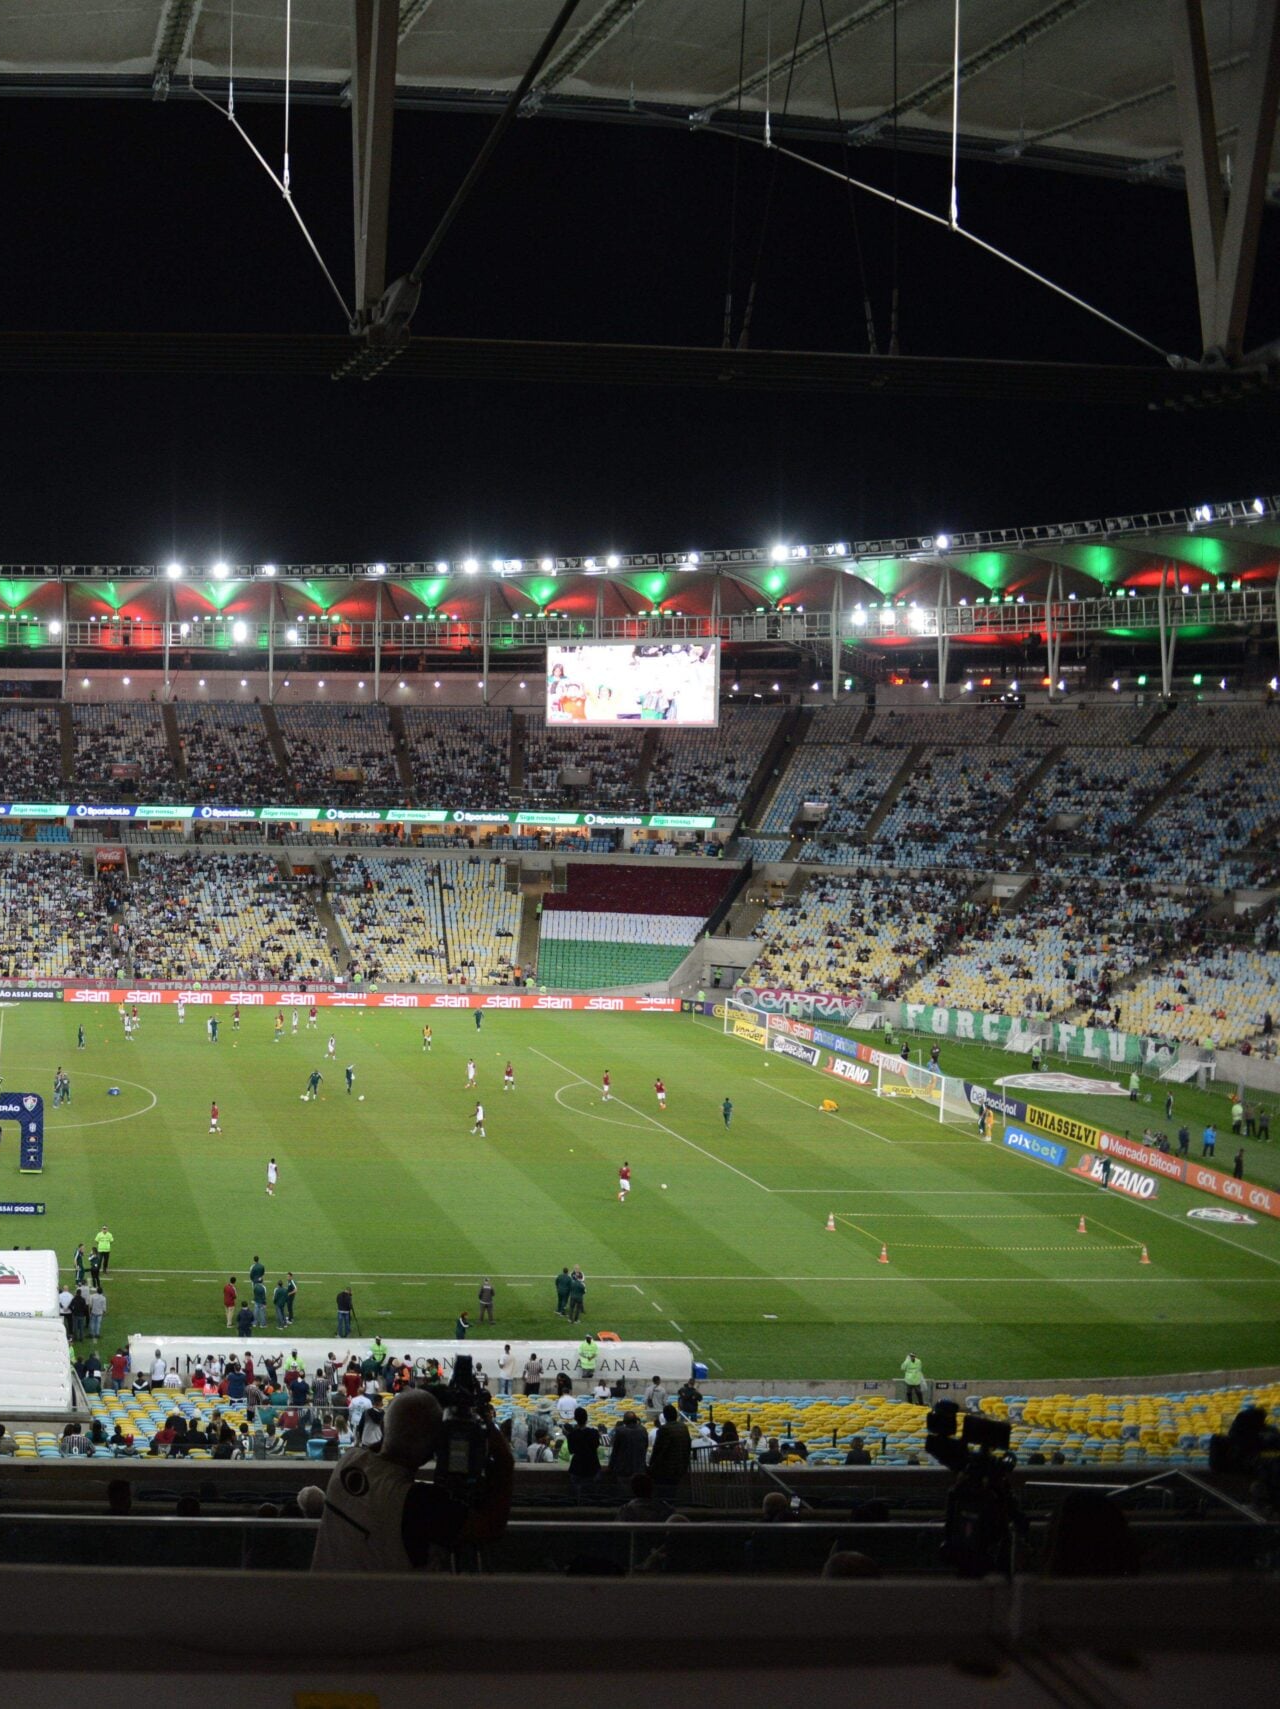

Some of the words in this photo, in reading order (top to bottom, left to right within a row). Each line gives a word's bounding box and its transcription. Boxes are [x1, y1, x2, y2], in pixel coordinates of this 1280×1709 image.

[17, 979, 62, 988] SCIO
[149, 981, 256, 991] TETRAAMPEÃO
[260, 983, 336, 992] BRASIEIRO
[70, 989, 109, 1002] stam
[124, 990, 161, 1003] stam
[173, 991, 212, 1004] stam
[224, 992, 263, 1005] stam
[276, 992, 315, 1005] stam
[378, 993, 418, 1006] stam
[430, 994, 469, 1007] stam
[481, 995, 521, 1008] stam
[532, 996, 572, 1008] stam
[584, 996, 623, 1009] stam
[1058, 1023, 1128, 1062] FLU
[833, 1058, 870, 1084] BETANO
[1029, 1108, 1097, 1146] UNIASSELVI
[1008, 1133, 1057, 1160] pixbet
[1109, 1139, 1148, 1163] Mercado
[1148, 1152, 1182, 1176] Bitcoin
[1196, 1171, 1218, 1190] GOL
[1222, 1180, 1244, 1200] GOL
[1249, 1190, 1272, 1210] GOL
